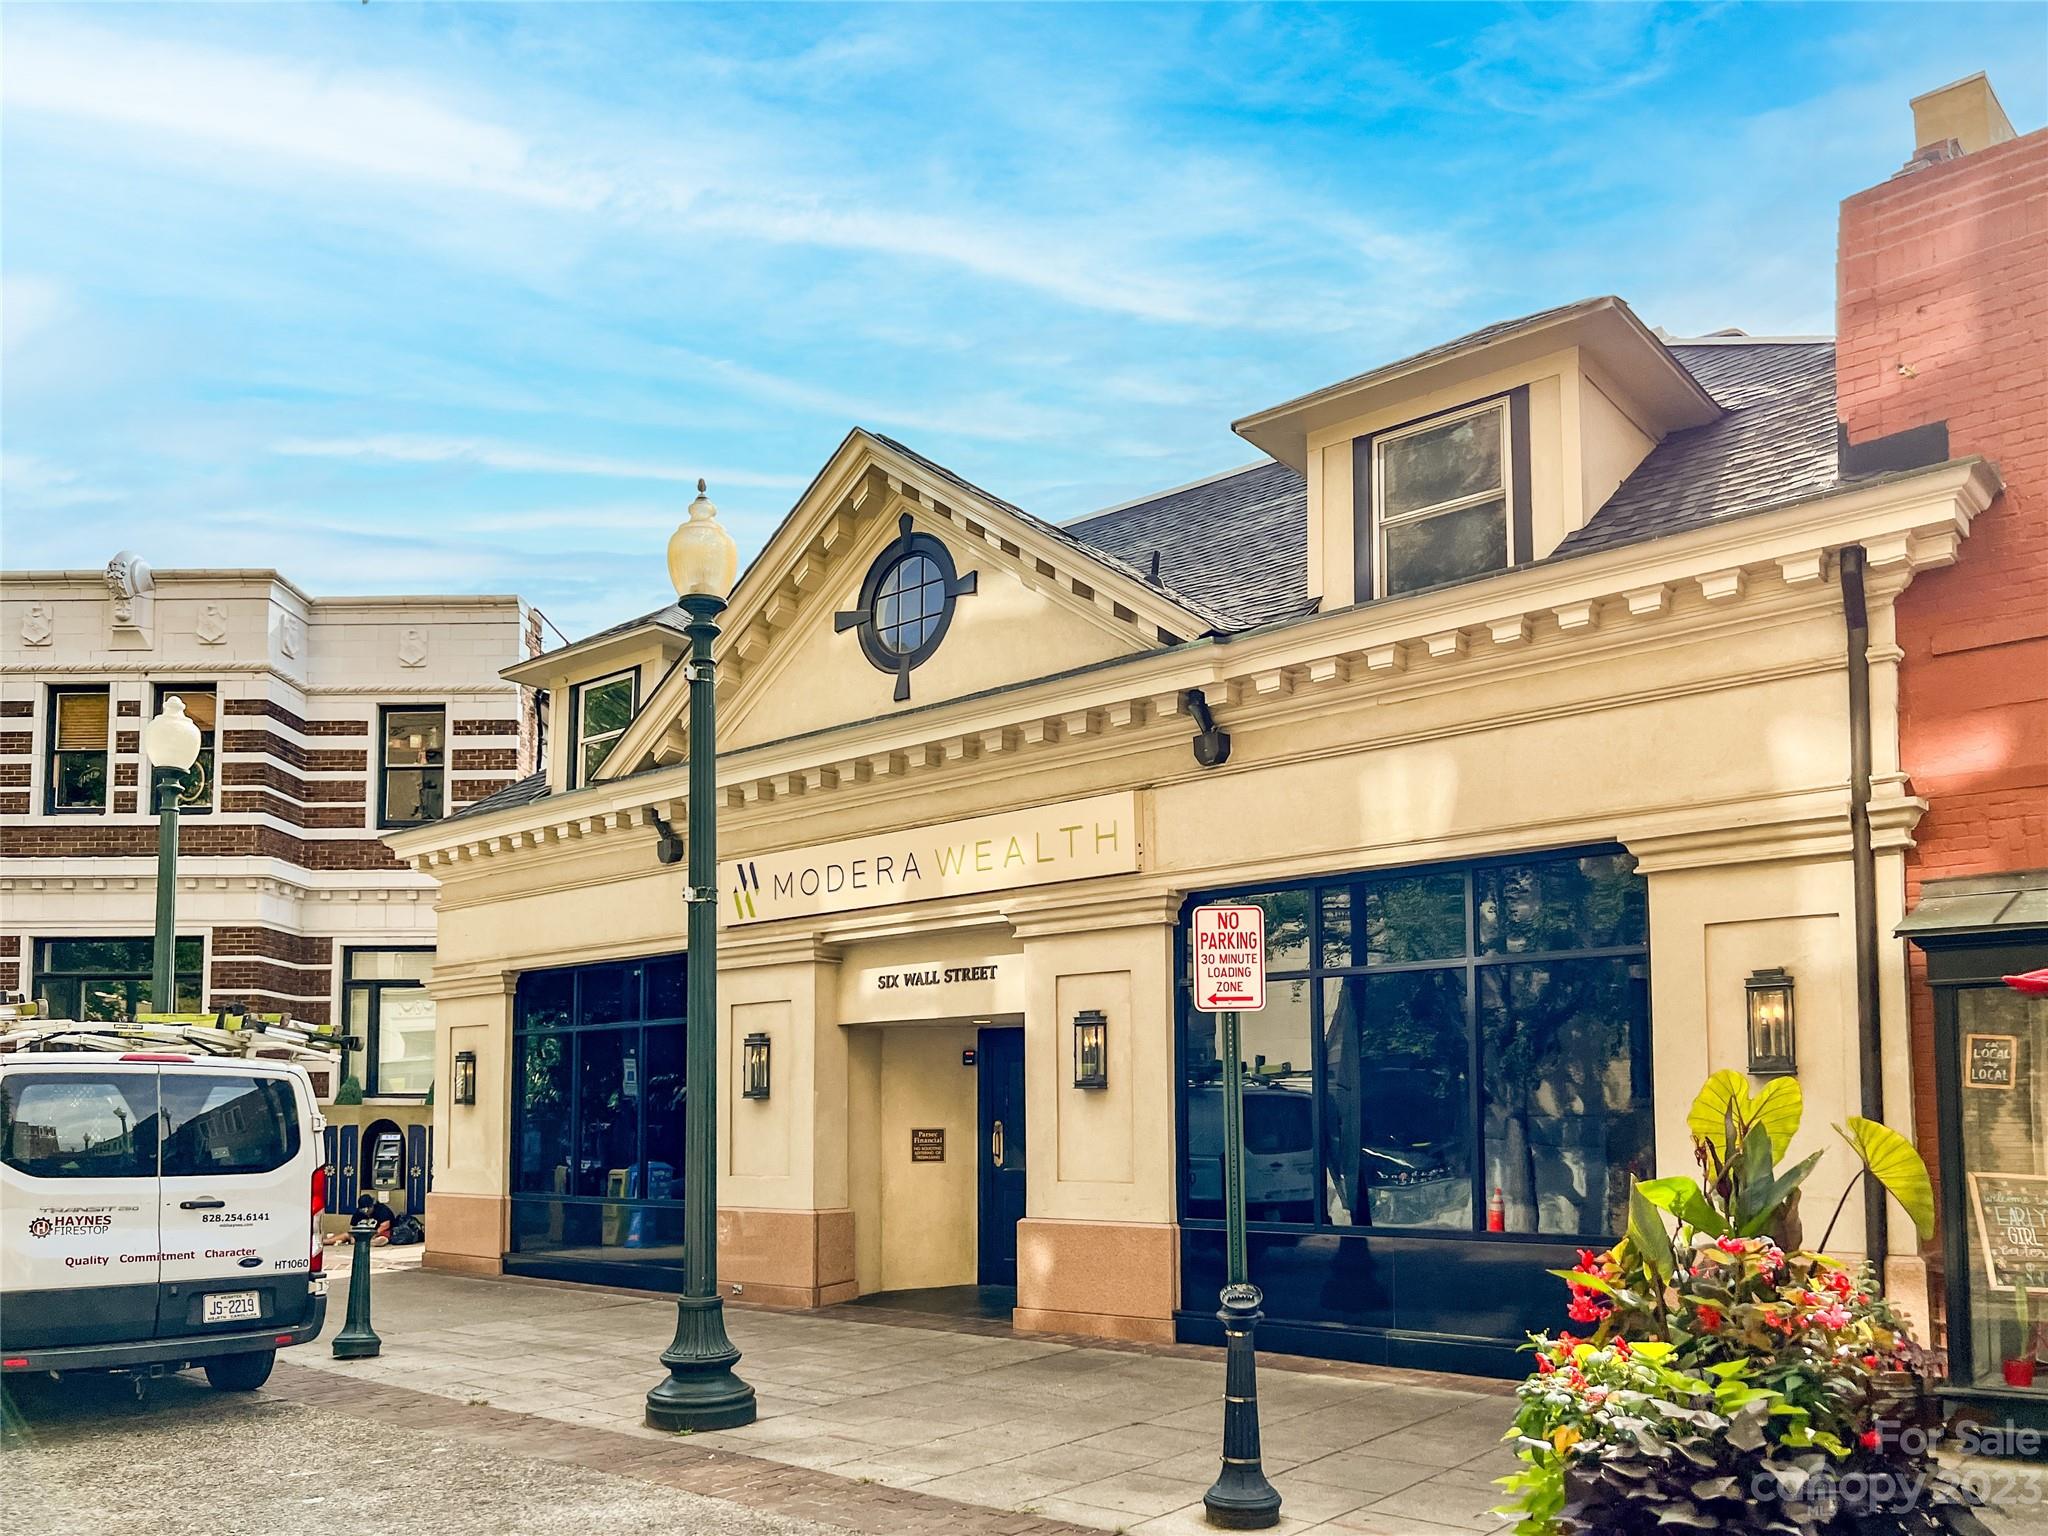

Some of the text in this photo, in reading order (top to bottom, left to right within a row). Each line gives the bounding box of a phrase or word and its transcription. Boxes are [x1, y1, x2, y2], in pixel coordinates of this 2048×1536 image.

[773, 819, 1118, 900] MODERA WEALTH
[1217, 912, 1239, 930] NO
[1200, 932, 1257, 950] PARKING
[1201, 953, 1258, 964] 30 MINUTE
[877, 964, 998, 990] SIX WALL STREET
[1207, 966, 1252, 978] LOADING
[1216, 981, 1244, 992] ZONE
[1973, 1048, 2010, 1059] LOCAL
[1971, 1068, 2009, 1081] LOCAL
[1983, 1191, 2030, 1204] welcome
[54, 1215, 112, 1226] HAYNES
[201, 1212, 270, 1223] 828.254.6141
[1994, 1205, 2047, 1229] EARLY
[54, 1225, 109, 1236] FIRESTOP
[2007, 1226, 2044, 1247] GIRL
[65, 1247, 257, 1268] Quality Commitment Character
[275, 1258, 309, 1270] HT1060
[209, 1298, 255, 1316] JS-2219
